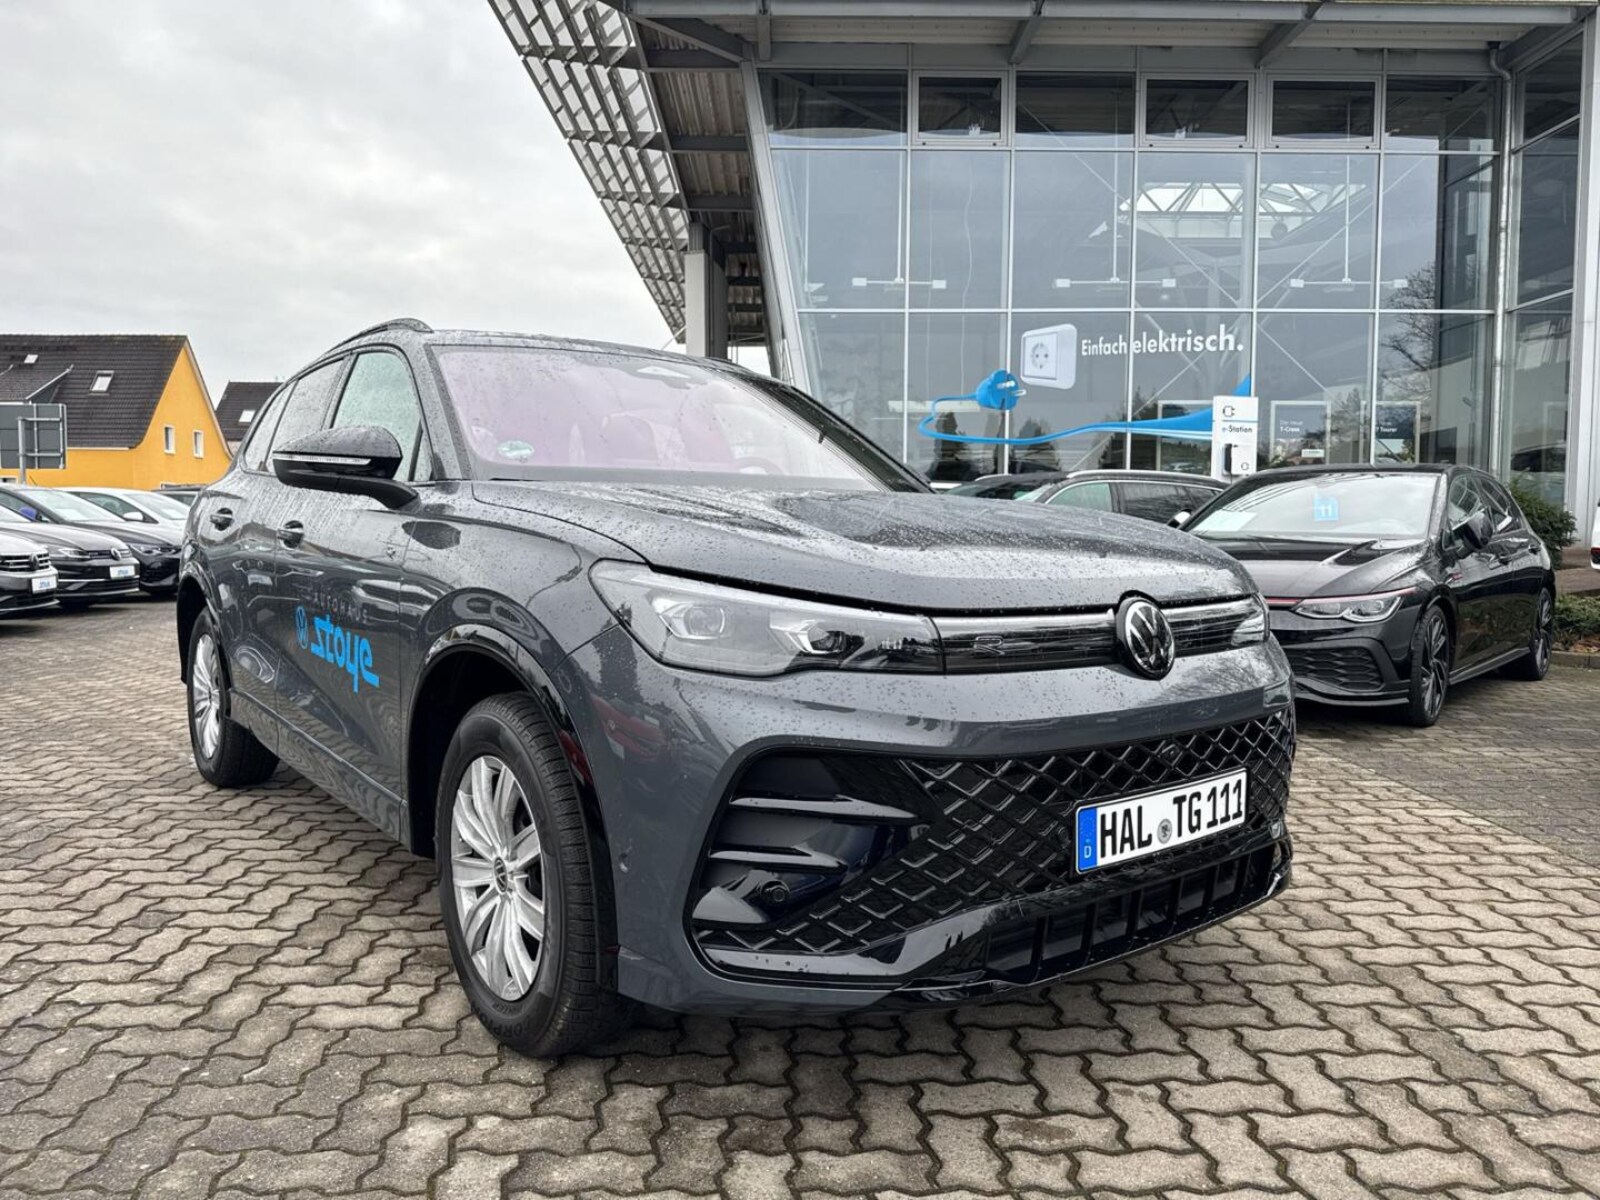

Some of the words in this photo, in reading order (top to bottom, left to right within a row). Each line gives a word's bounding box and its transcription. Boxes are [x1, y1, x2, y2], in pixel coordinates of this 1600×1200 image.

[1081, 334, 1127, 356] Einfach
[1132, 323, 1244, 354] elektrisch.
[1221, 425, 1253, 433] e-Station
[1100, 805, 1153, 859] HAL
[1173, 792, 1202, 838] TG
[1206, 779, 1243, 830] 111
[1083, 845, 1092, 859] D
